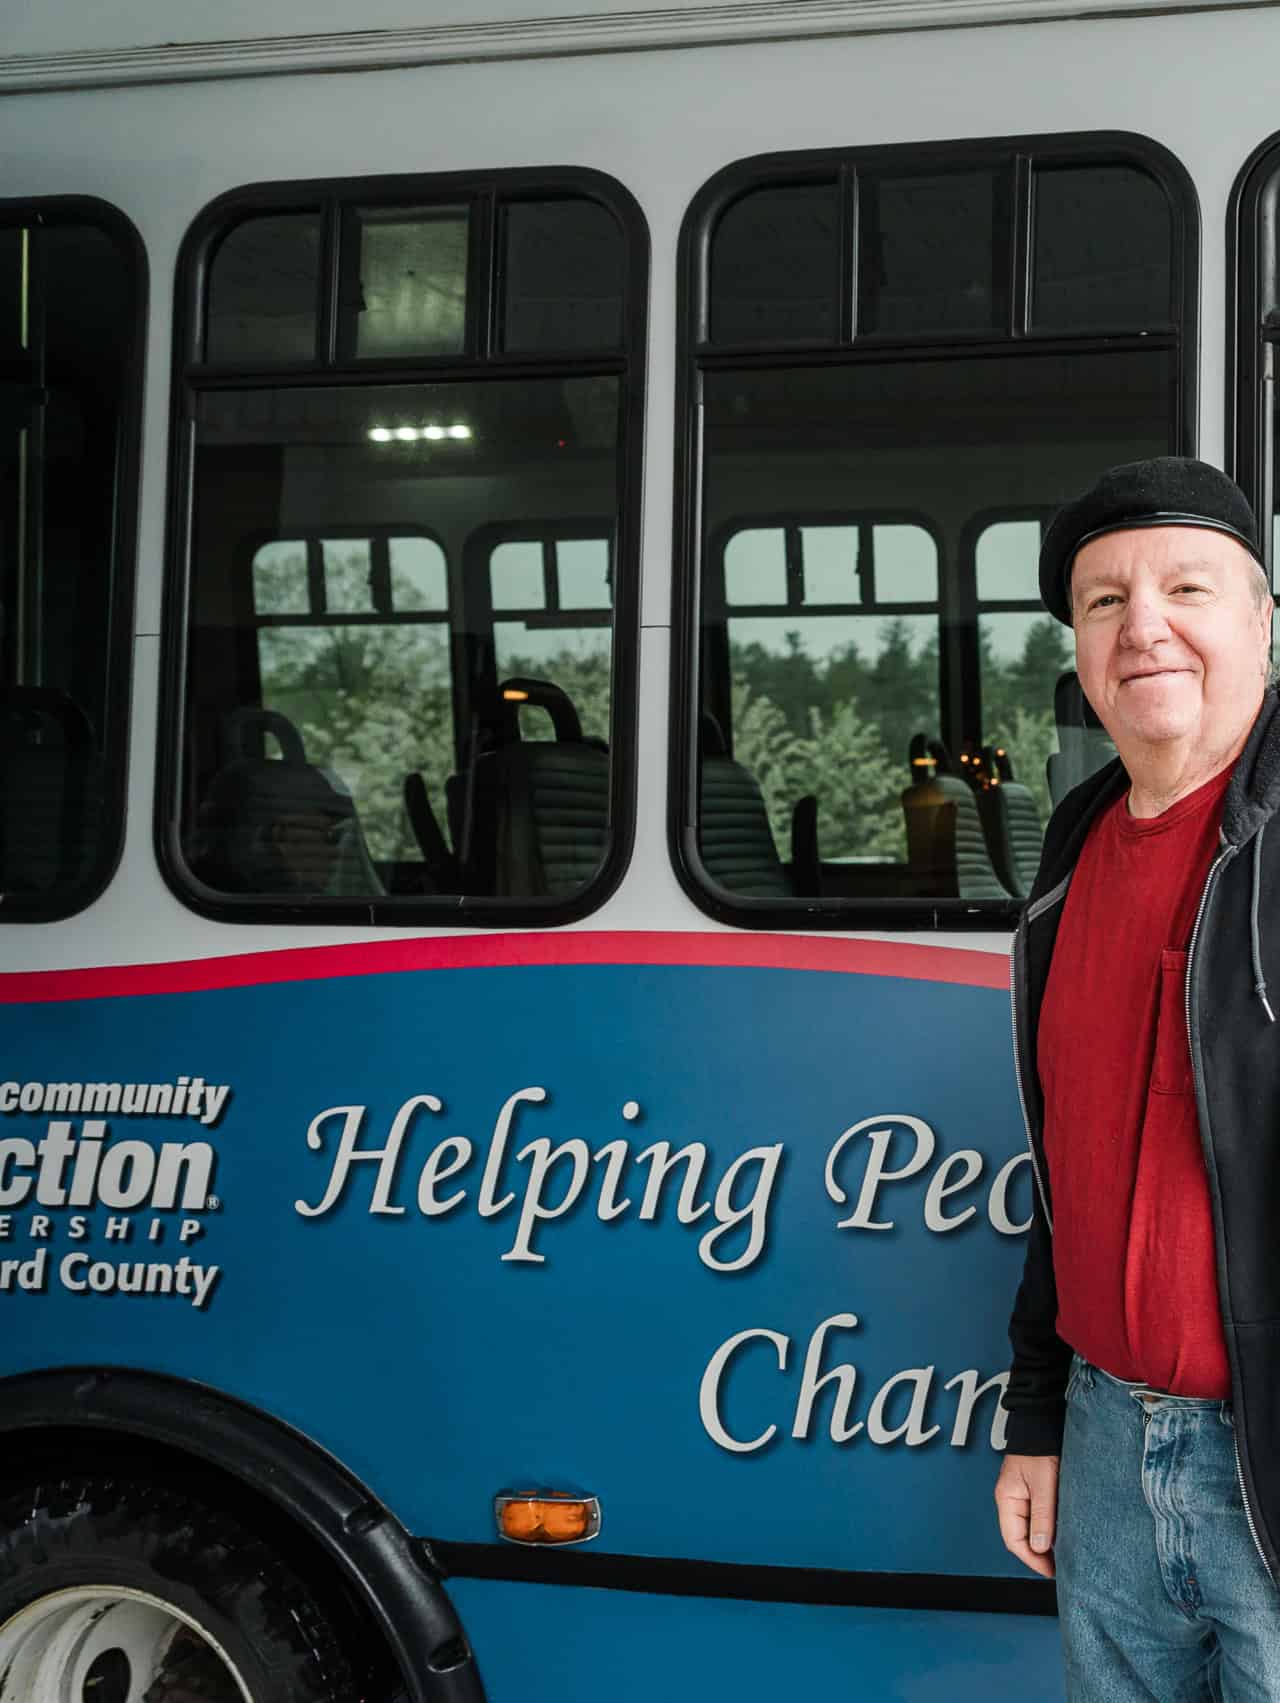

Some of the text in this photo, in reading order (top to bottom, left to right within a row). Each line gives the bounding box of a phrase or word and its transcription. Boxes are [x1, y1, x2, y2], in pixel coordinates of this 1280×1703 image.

[0, 1076, 230, 1124] community
[294, 1086, 784, 1272] Helping
[59, 1251, 219, 1306] County
